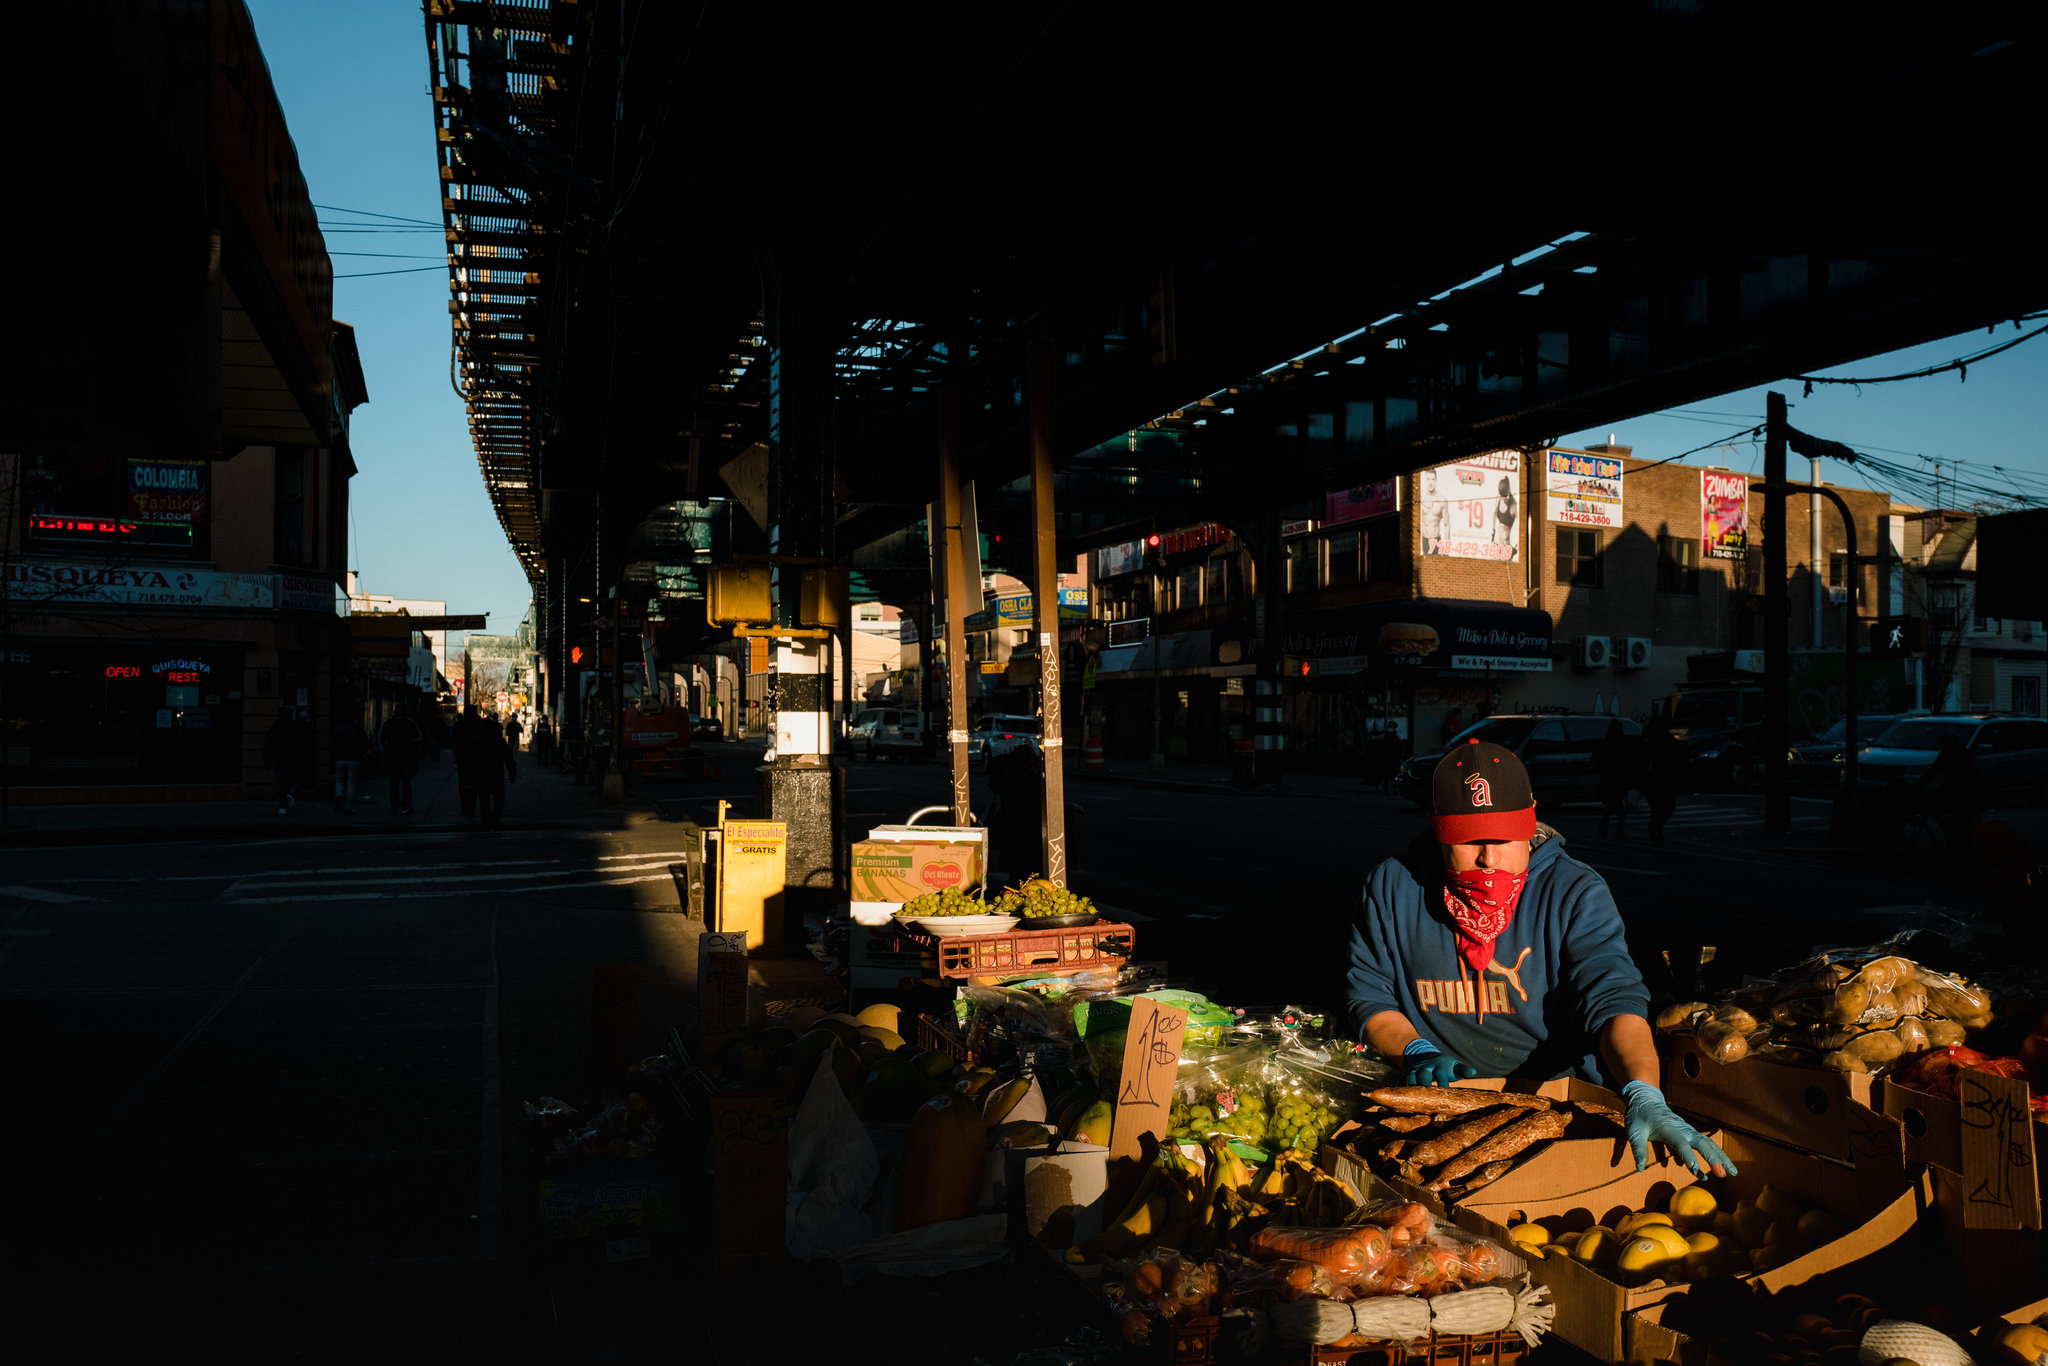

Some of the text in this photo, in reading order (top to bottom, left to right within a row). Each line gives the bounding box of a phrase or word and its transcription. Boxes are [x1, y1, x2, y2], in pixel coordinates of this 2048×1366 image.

[1551, 455, 1620, 477] After School Center
[134, 465, 199, 490] COLOMBIA
[1706, 475, 1745, 500] ZUMBA
[1560, 511, 1611, 525] 718-429-3600
[1428, 539, 1513, 560] 718-429-3600
[999, 598, 1017, 613] OSHA
[1457, 626, 1488, 645] Mike's
[1489, 629, 1508, 646] Deli
[1516, 632, 1548, 651] Grocery
[152, 659, 211, 675] QUISQUEYA
[1393, 656, 1422, 665] 97-02
[1497, 658, 1518, 669] Stamp
[1520, 660, 1548, 669] Accepted
[106, 666, 140, 678] OPEN
[168, 671, 200, 683] REST.
[727, 826, 783, 840] El Especialito
[742, 846, 777, 854] GRATIS
[856, 857, 900, 867] Premium
[856, 868, 907, 878] BANANAS
[924, 870, 960, 880] Del Monte
[1416, 979, 1511, 1014] PUMA
